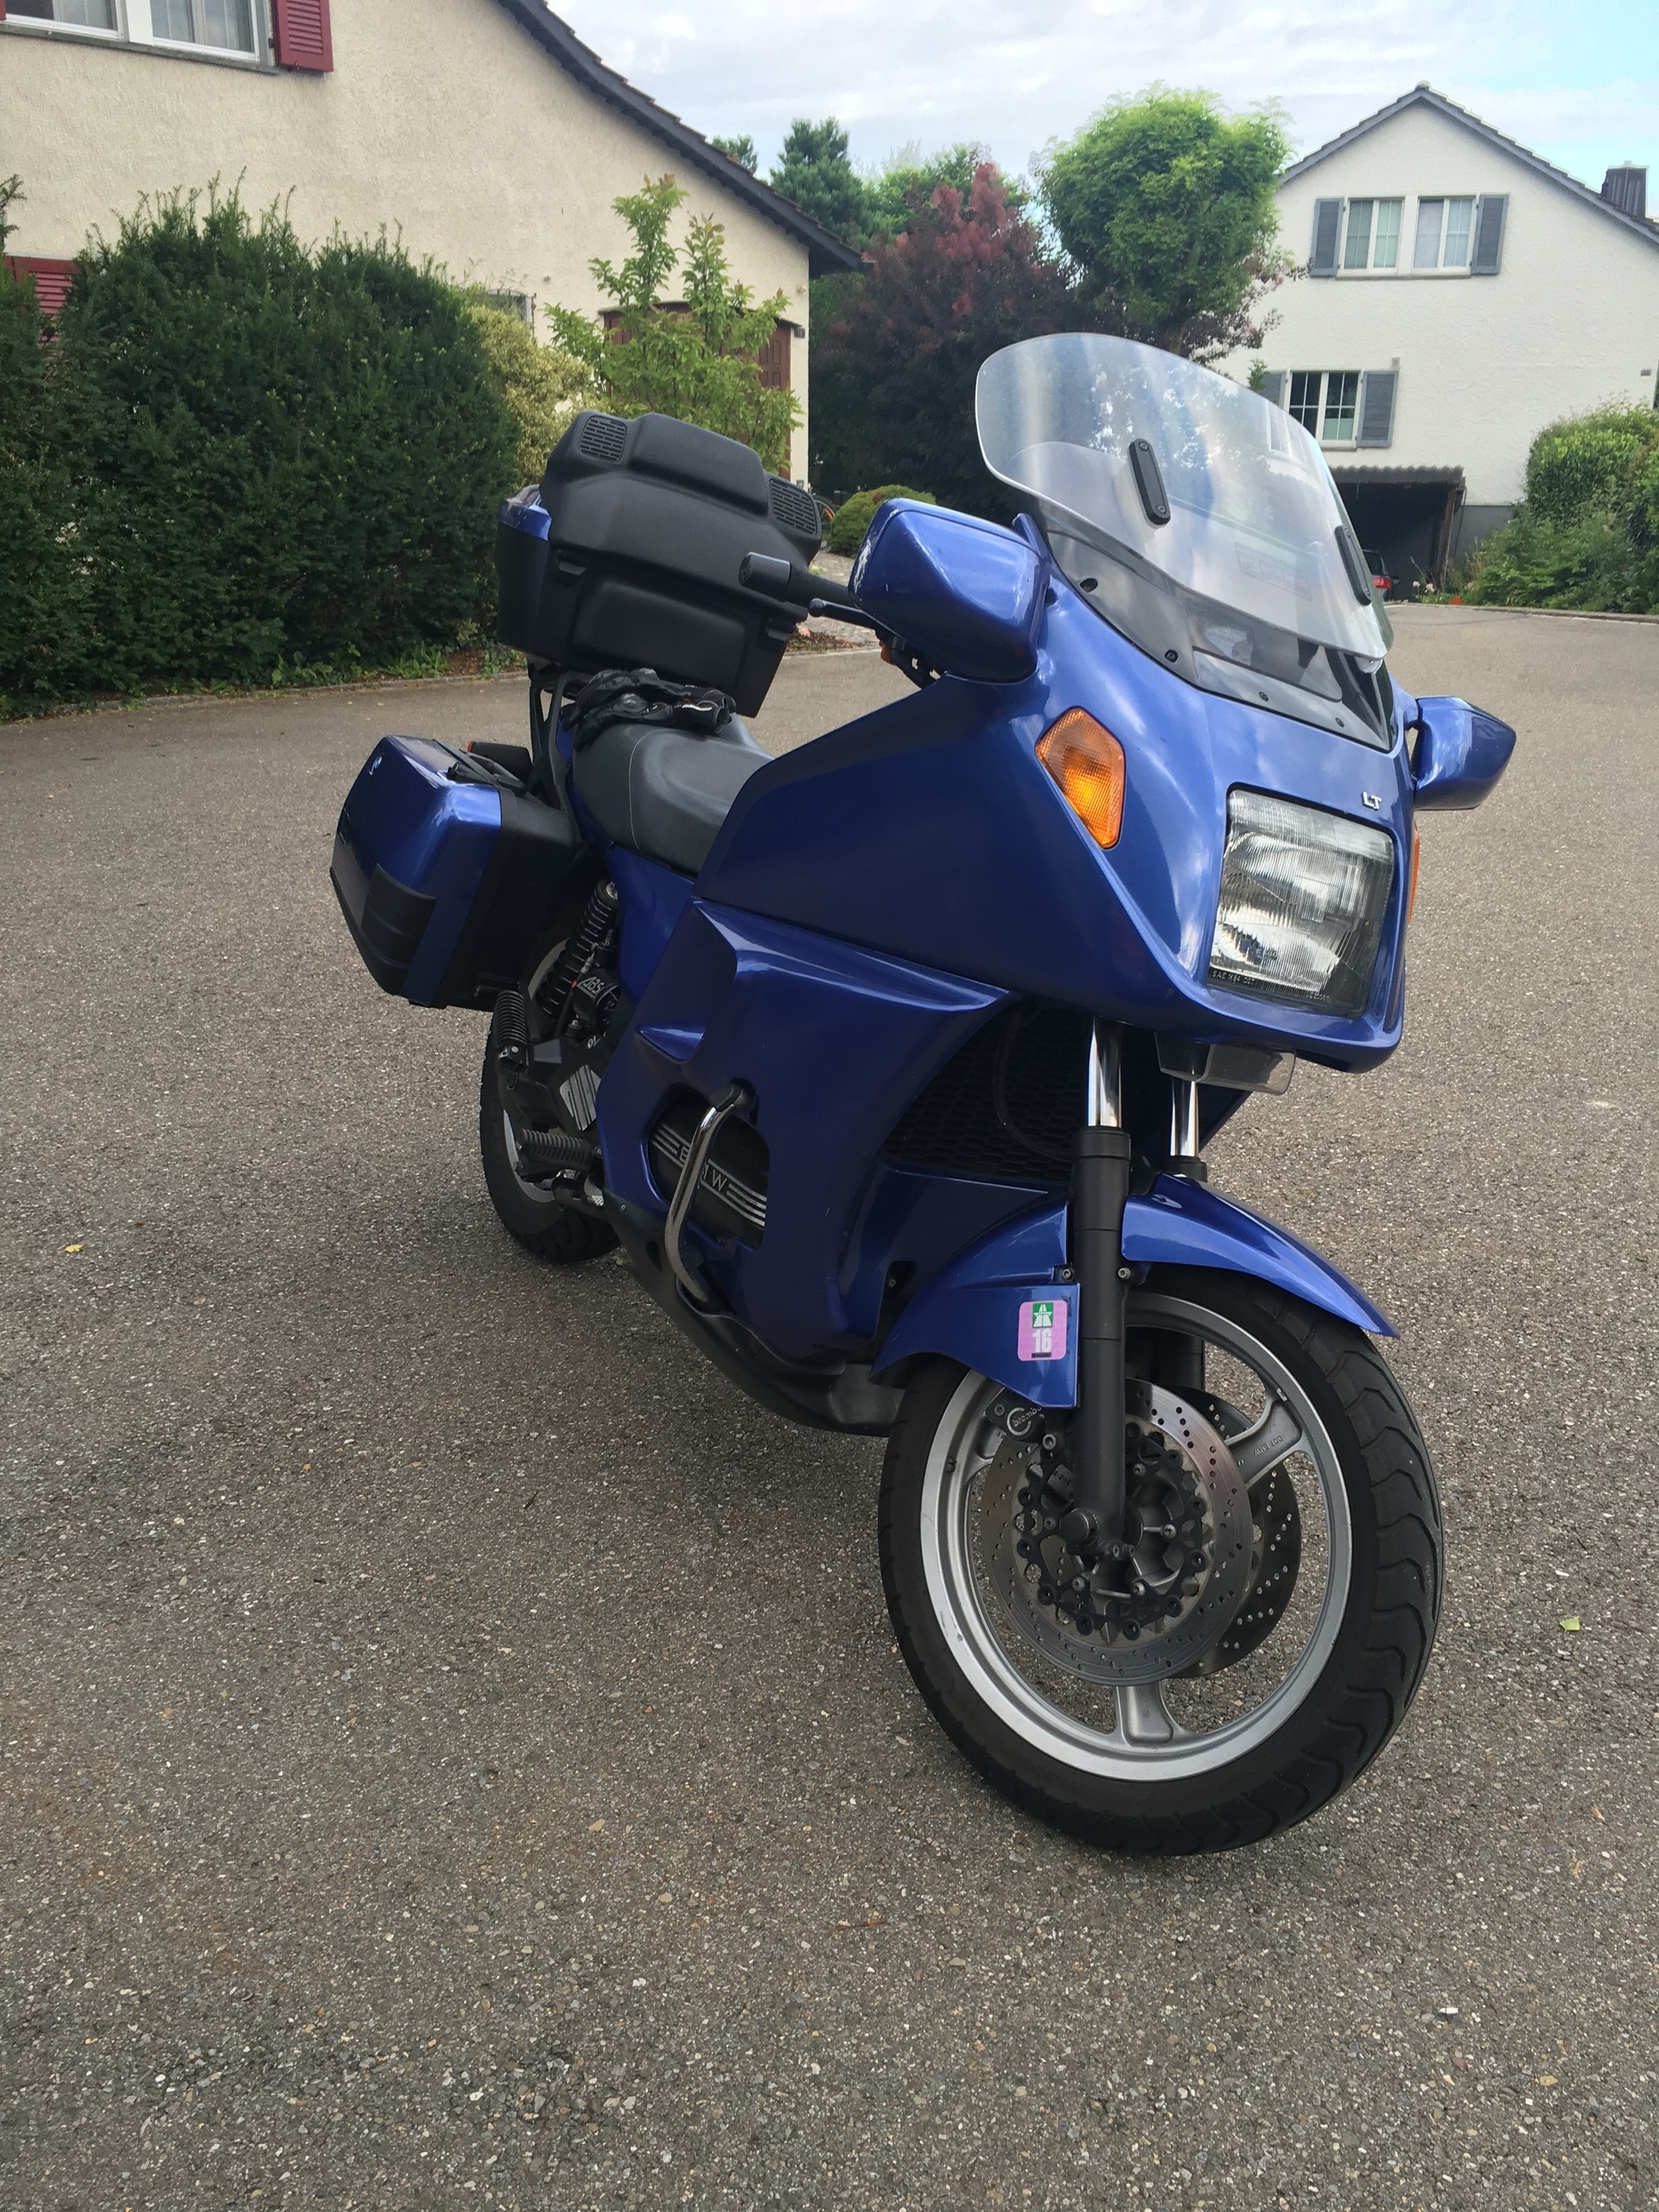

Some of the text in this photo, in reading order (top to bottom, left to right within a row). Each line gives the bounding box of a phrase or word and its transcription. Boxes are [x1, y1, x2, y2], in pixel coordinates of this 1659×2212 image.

[1362, 791, 1382, 810] LT
[1211, 970, 1226, 980] SAE
[577, 976, 605, 995] ABS
[1032, 1328, 1052, 1353] 16
